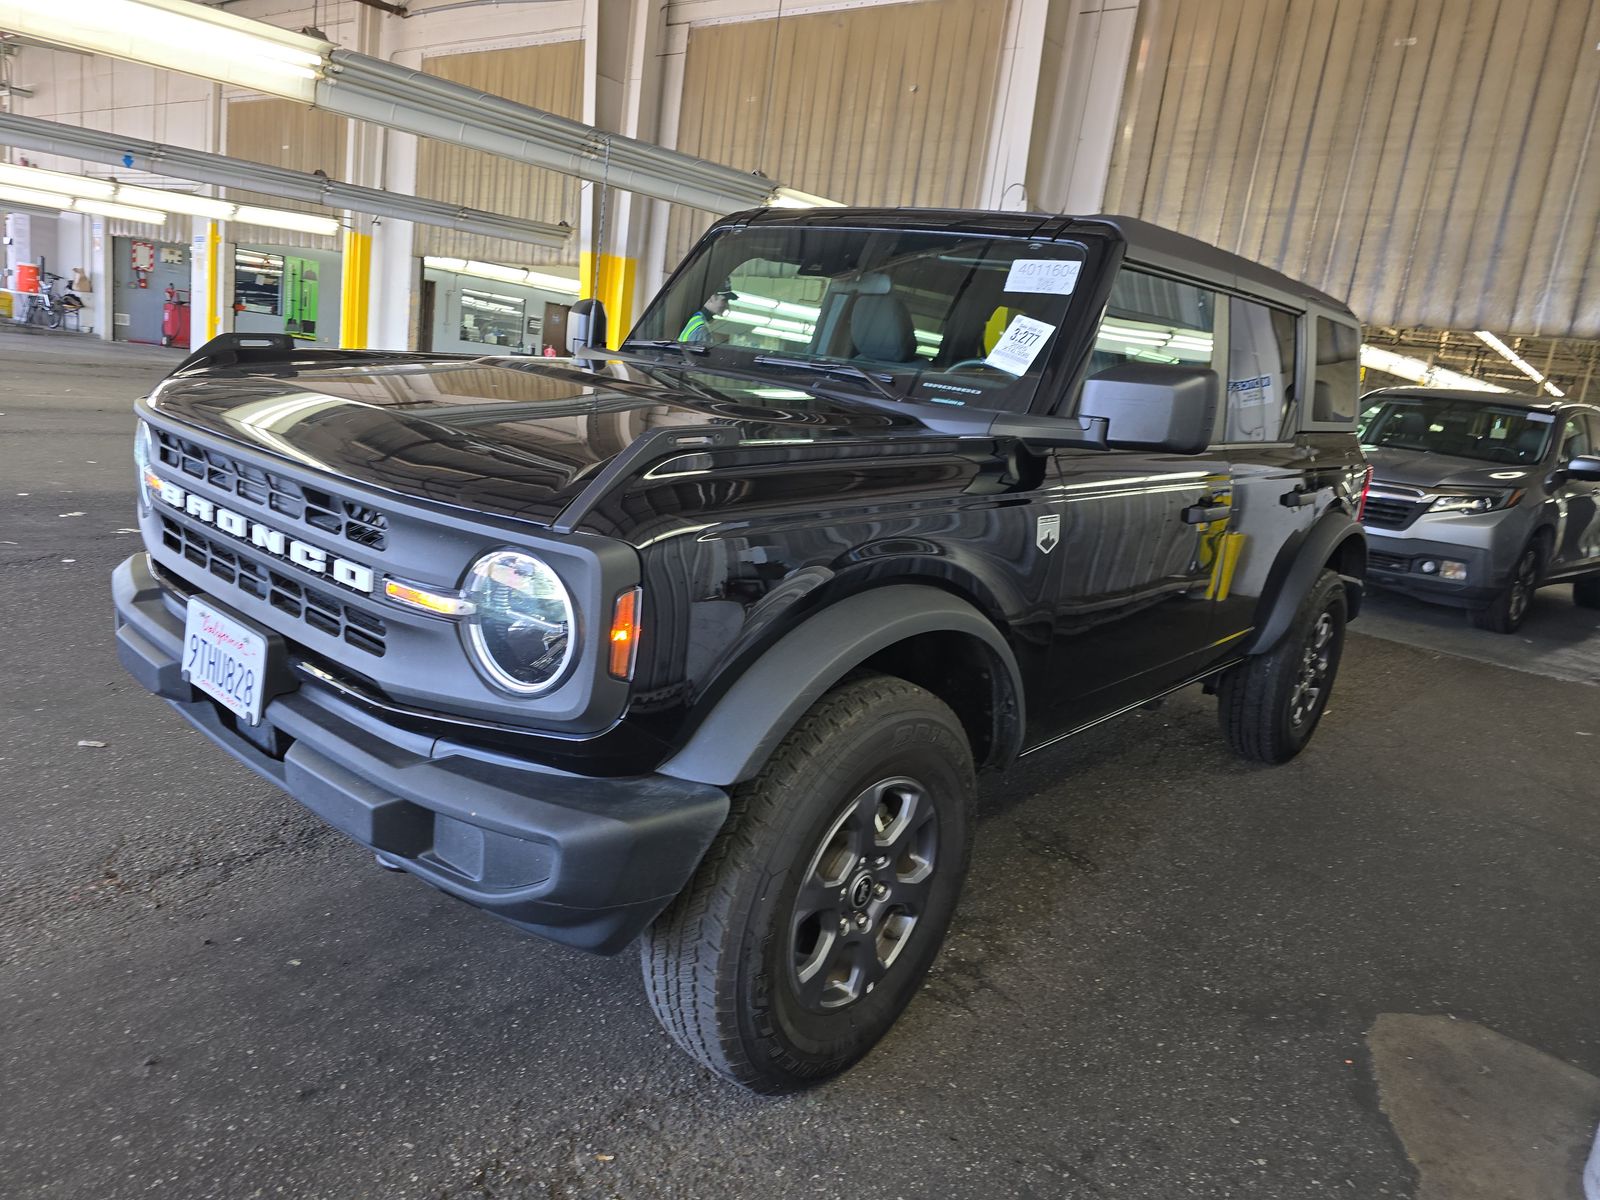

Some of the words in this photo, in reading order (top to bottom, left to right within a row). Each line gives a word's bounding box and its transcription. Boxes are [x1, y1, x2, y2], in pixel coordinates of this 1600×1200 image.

[1018, 263, 1077, 277] 4011604
[1010, 327, 1041, 347] 3:277
[161, 481, 374, 593] BRONCO
[188, 634, 255, 708] 9THU828
